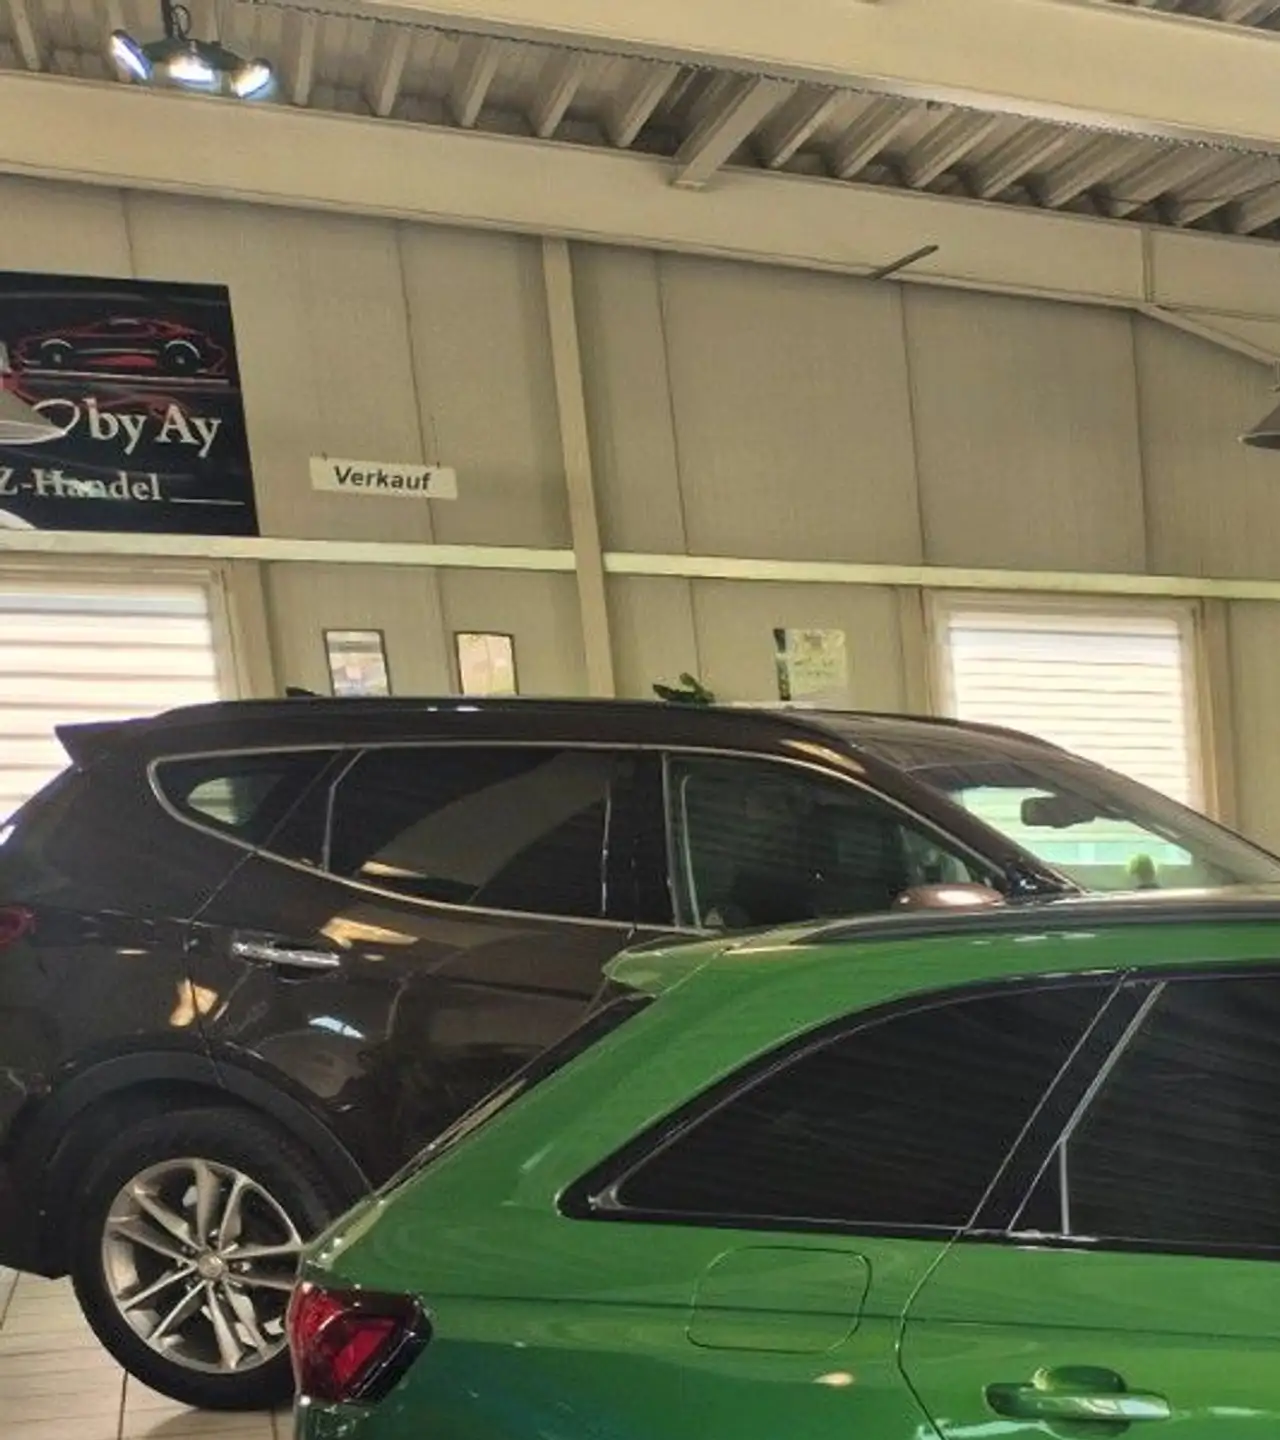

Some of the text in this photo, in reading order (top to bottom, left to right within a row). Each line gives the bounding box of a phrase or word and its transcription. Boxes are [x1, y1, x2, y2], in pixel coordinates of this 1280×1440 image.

[82, 397, 222, 458] by Ay
[333, 465, 432, 491] Verkauf
